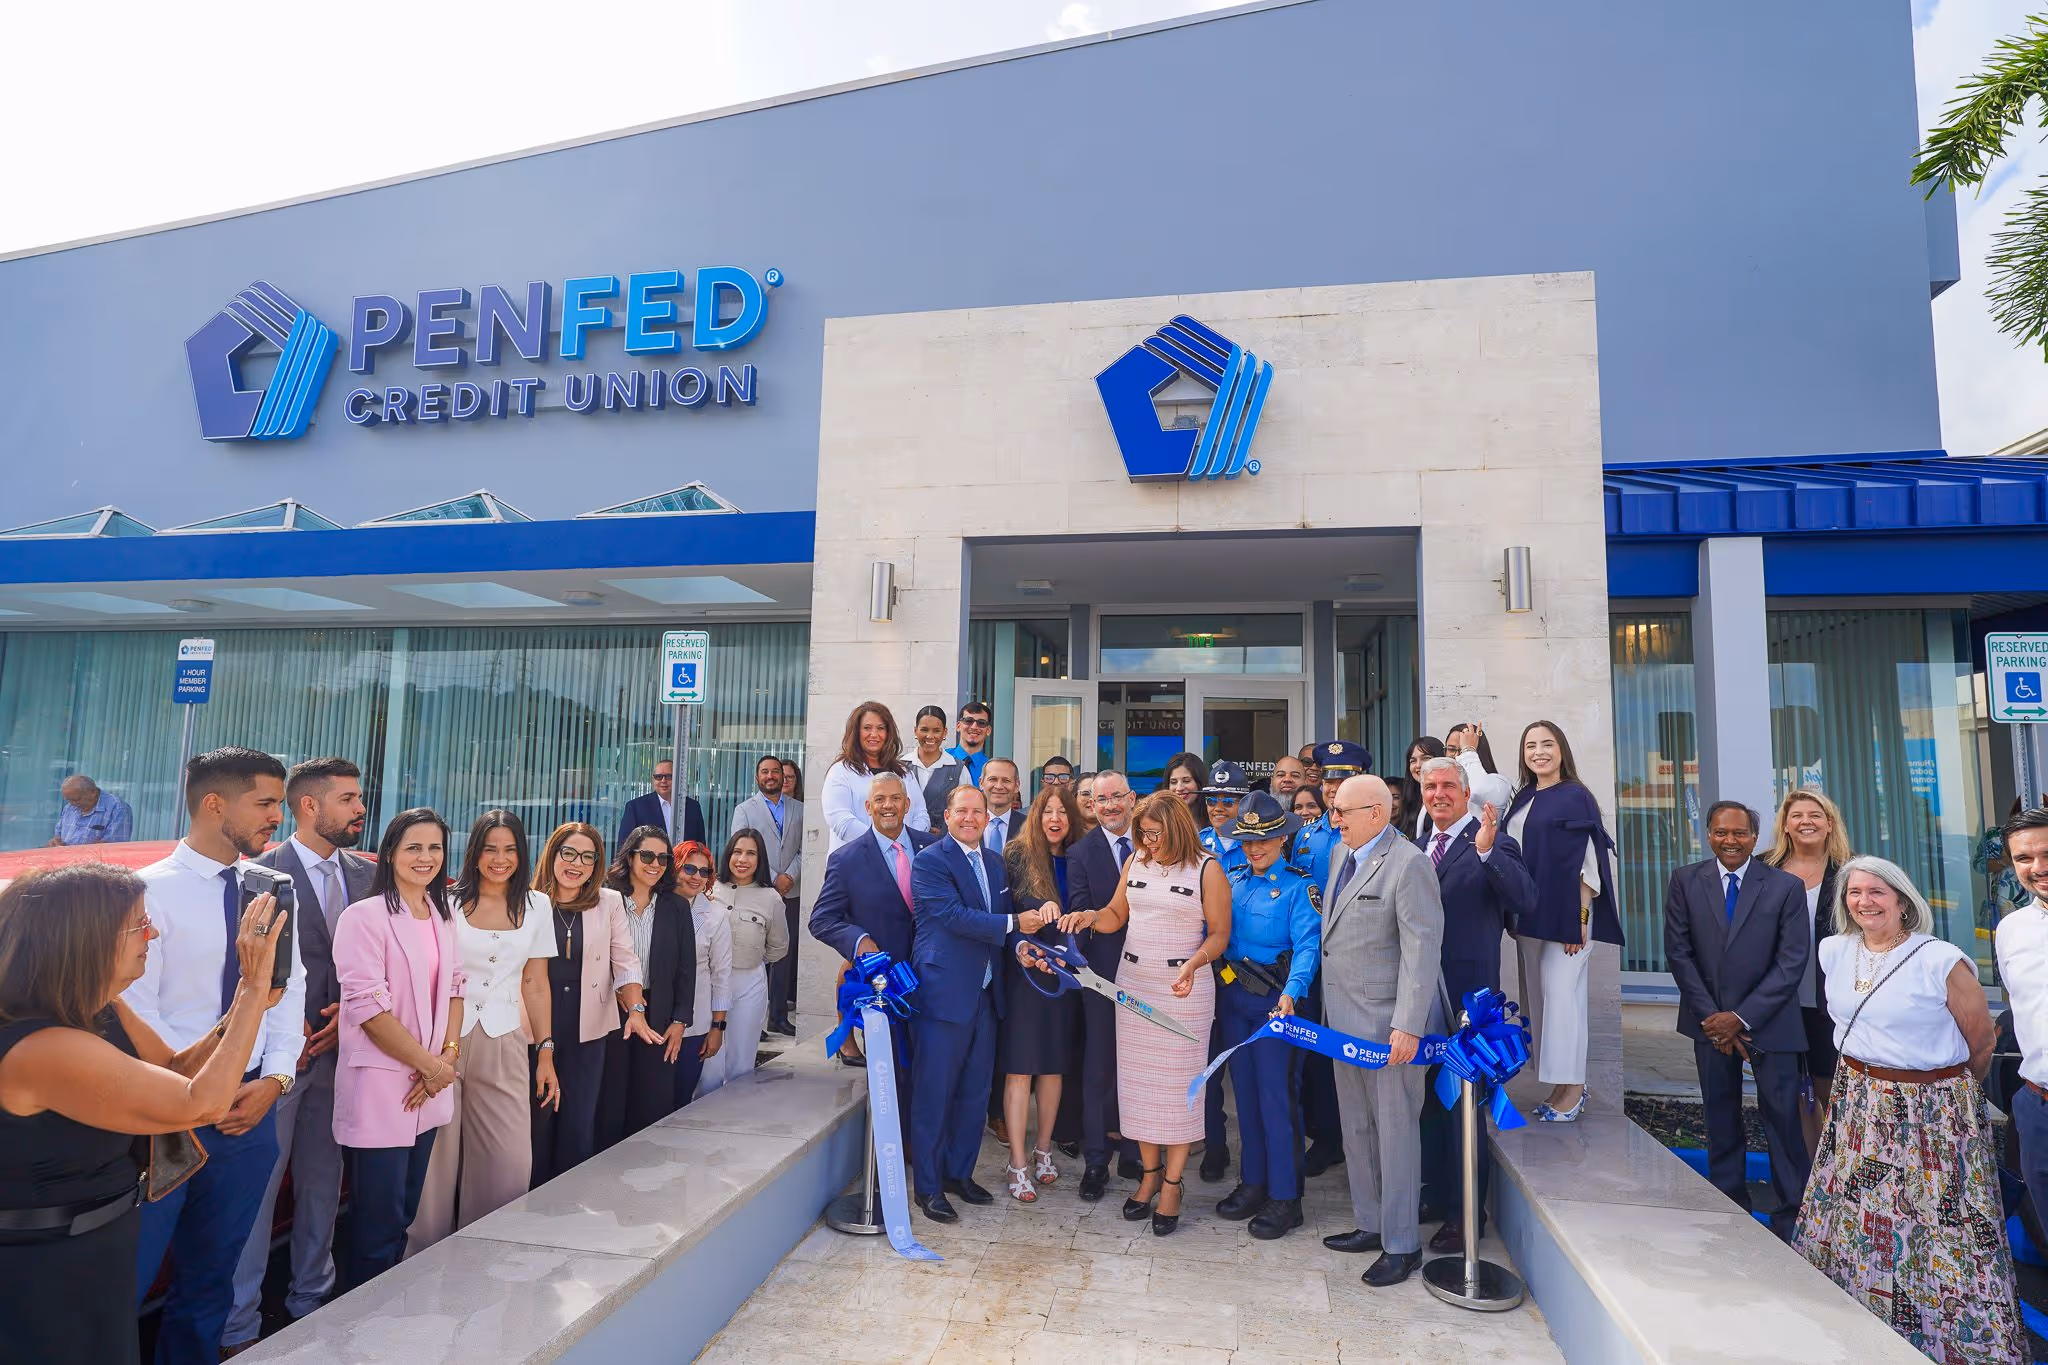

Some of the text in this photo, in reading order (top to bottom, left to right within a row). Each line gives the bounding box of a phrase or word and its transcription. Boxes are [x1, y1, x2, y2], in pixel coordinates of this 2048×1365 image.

[348, 265, 768, 374] PENFED
[344, 363, 758, 428] CREDIT UNION
[666, 638, 705, 648] RESERVED
[1991, 641, 2048, 653] RESERVED
[668, 650, 702, 660] PARKING
[1996, 656, 2047, 668] PARKING
[1149, 720, 1184, 730] UNIO
[1284, 1022, 1318, 1040] PENFED
[1358, 1056, 1379, 1064] CREDIT
[1359, 1048, 1391, 1060] PENF
